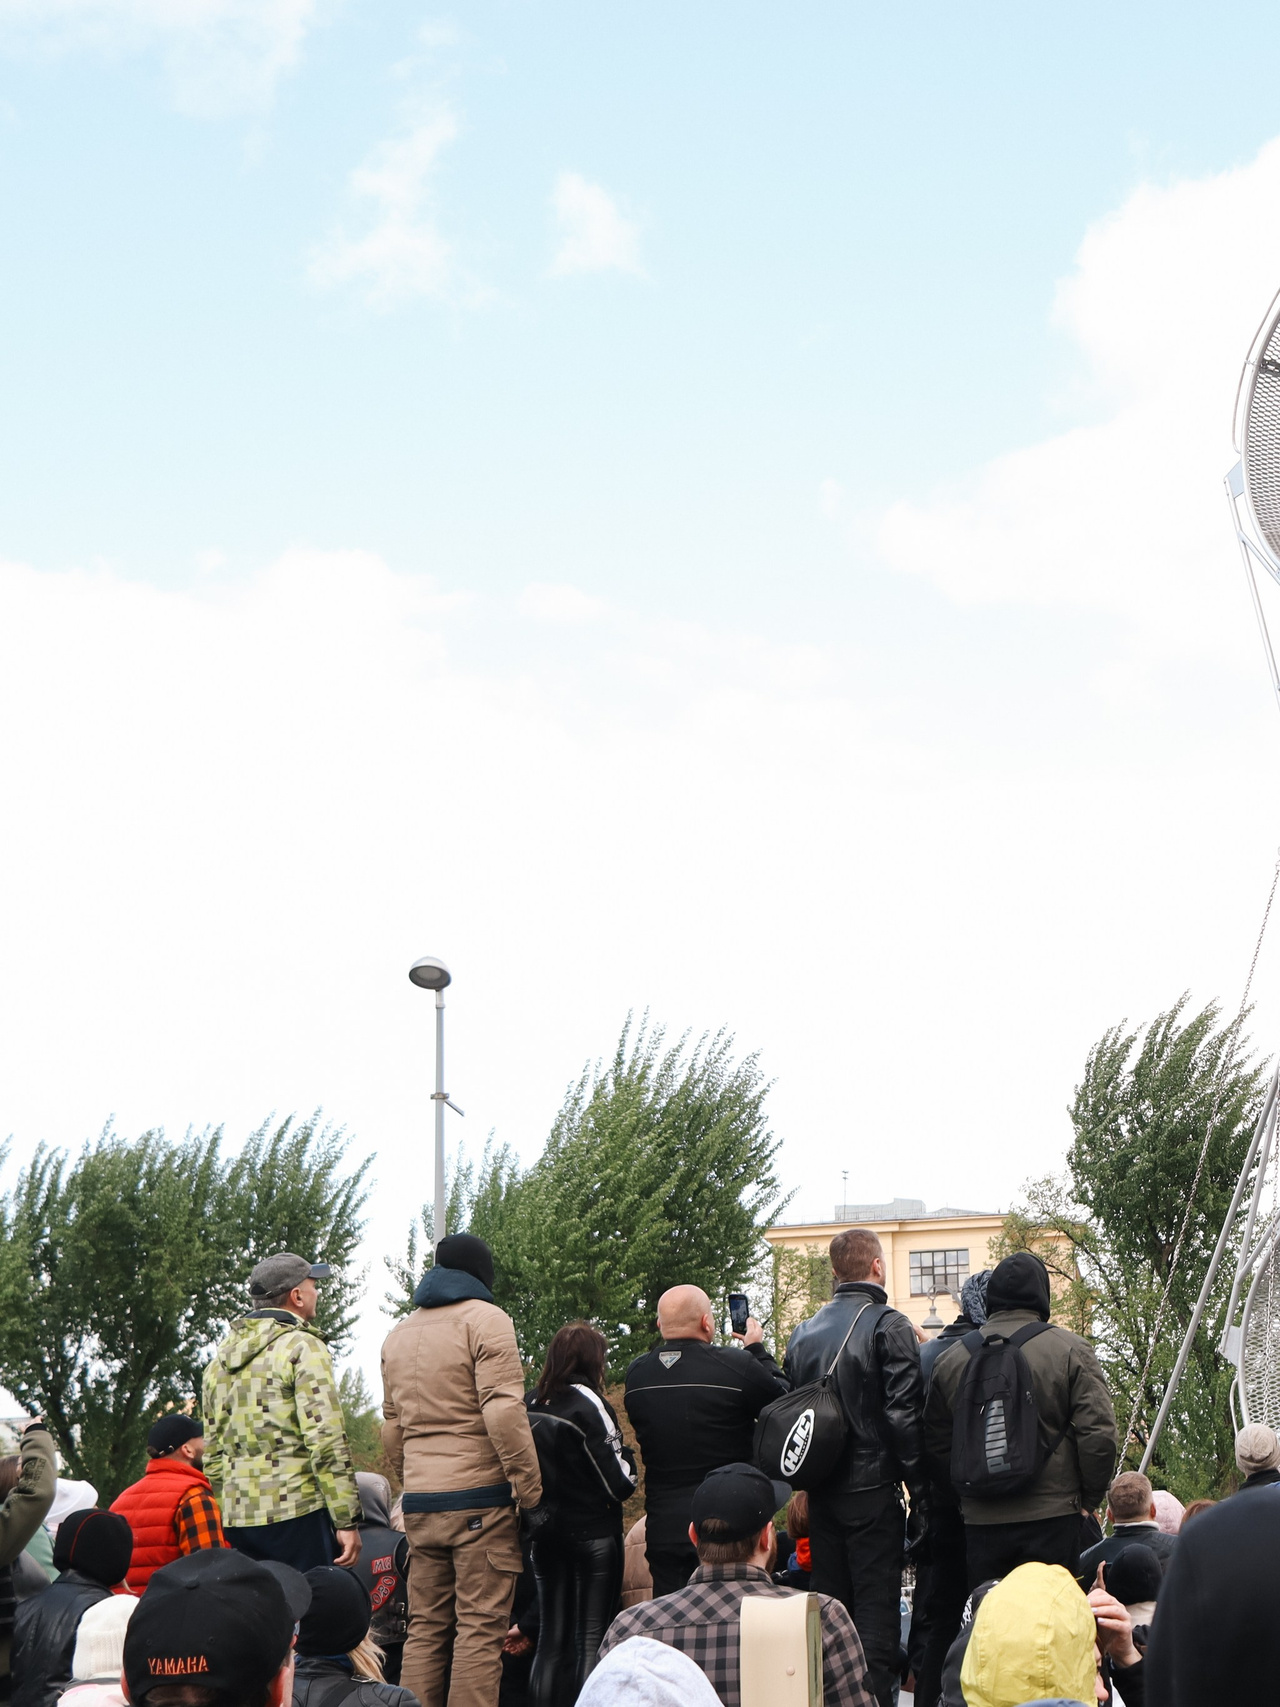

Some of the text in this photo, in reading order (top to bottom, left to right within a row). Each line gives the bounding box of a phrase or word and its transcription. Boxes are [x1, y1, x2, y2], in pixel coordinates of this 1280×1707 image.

[784, 1416, 811, 1471] HJC
[985, 1400, 1011, 1474] PUMA
[147, 1655, 209, 1675] YAMAHA
